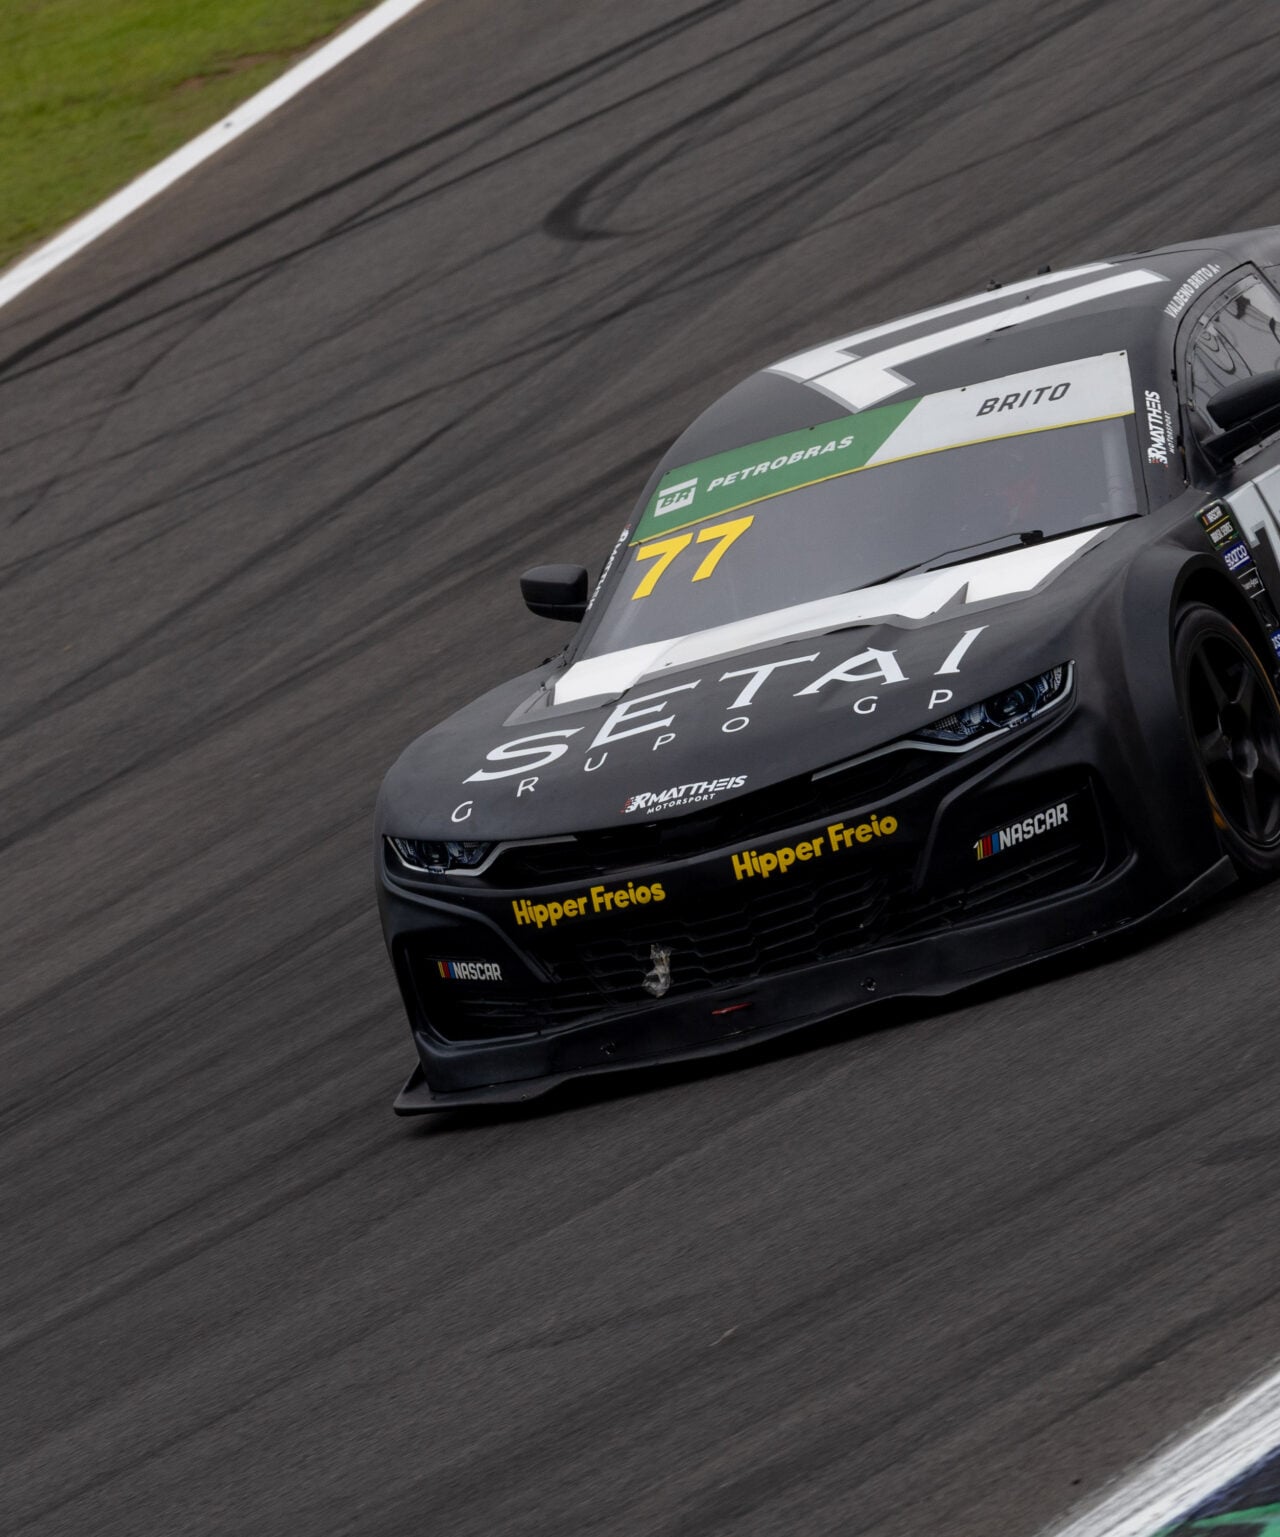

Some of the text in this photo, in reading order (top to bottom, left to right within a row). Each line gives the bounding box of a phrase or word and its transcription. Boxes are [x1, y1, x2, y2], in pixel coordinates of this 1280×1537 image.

[1163, 283, 1195, 318] VALDENO
[1186, 267, 1213, 290] BRITO
[976, 381, 1071, 417] BRITO
[706, 435, 855, 493] PETROBRAS
[632, 515, 755, 601] 77
[462, 625, 989, 785] SETAI
[450, 716, 750, 823] GRUPO
[646, 792, 716, 815] MOTORSPORT
[999, 802, 1069, 851] NASCAR
[732, 814, 898, 880] Hipper Freio
[512, 881, 666, 928] Hipper Freios
[452, 962, 503, 980] NASCAR
